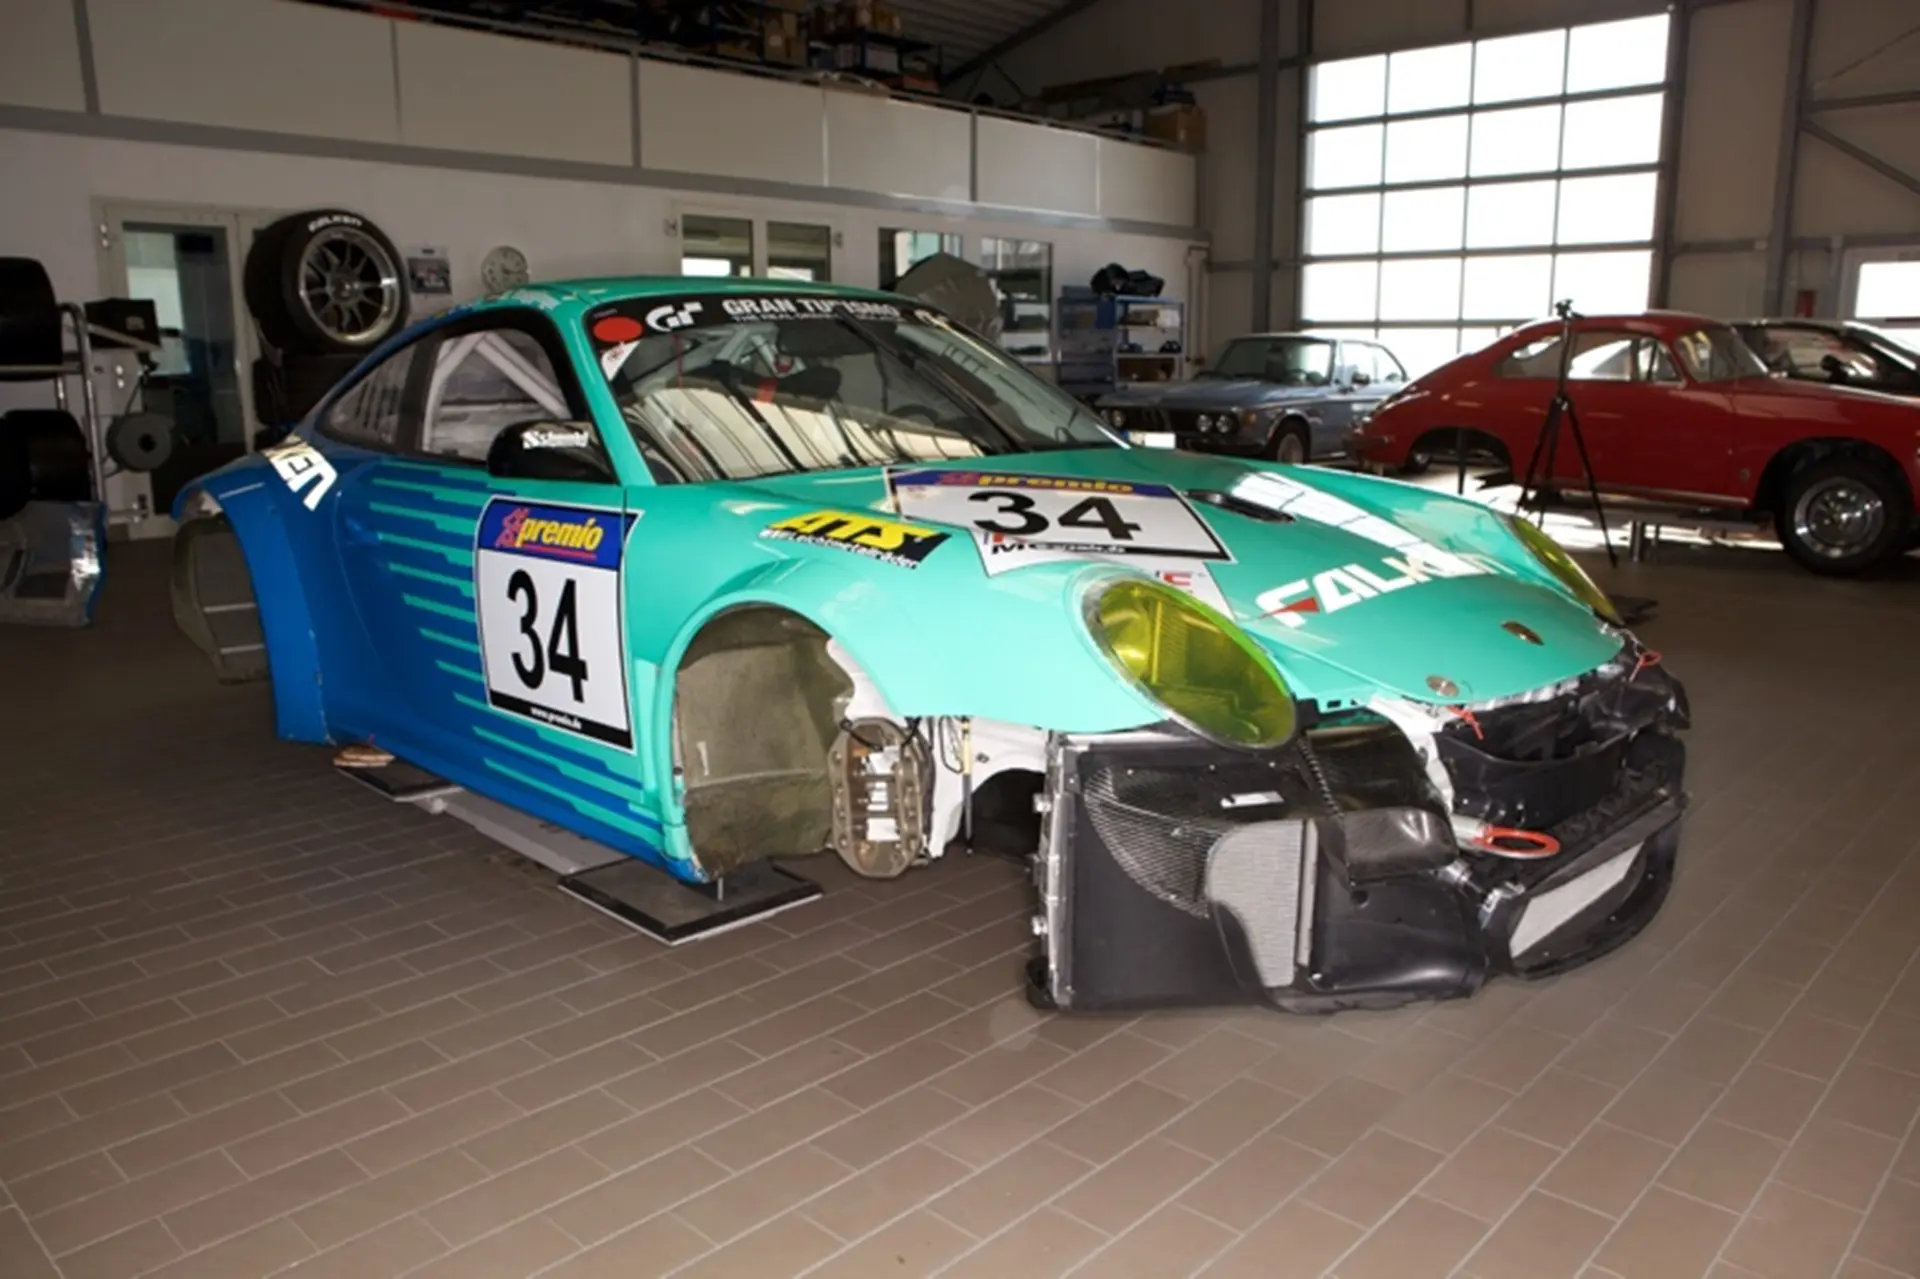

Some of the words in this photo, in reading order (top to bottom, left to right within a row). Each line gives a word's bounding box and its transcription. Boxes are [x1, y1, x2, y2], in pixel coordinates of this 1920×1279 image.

[721, 299, 796, 316] GRAN
[769, 509, 942, 551] ATS
[967, 490, 1142, 541] 34
[1255, 554, 1516, 629] FALK
[506, 568, 589, 704] 34
